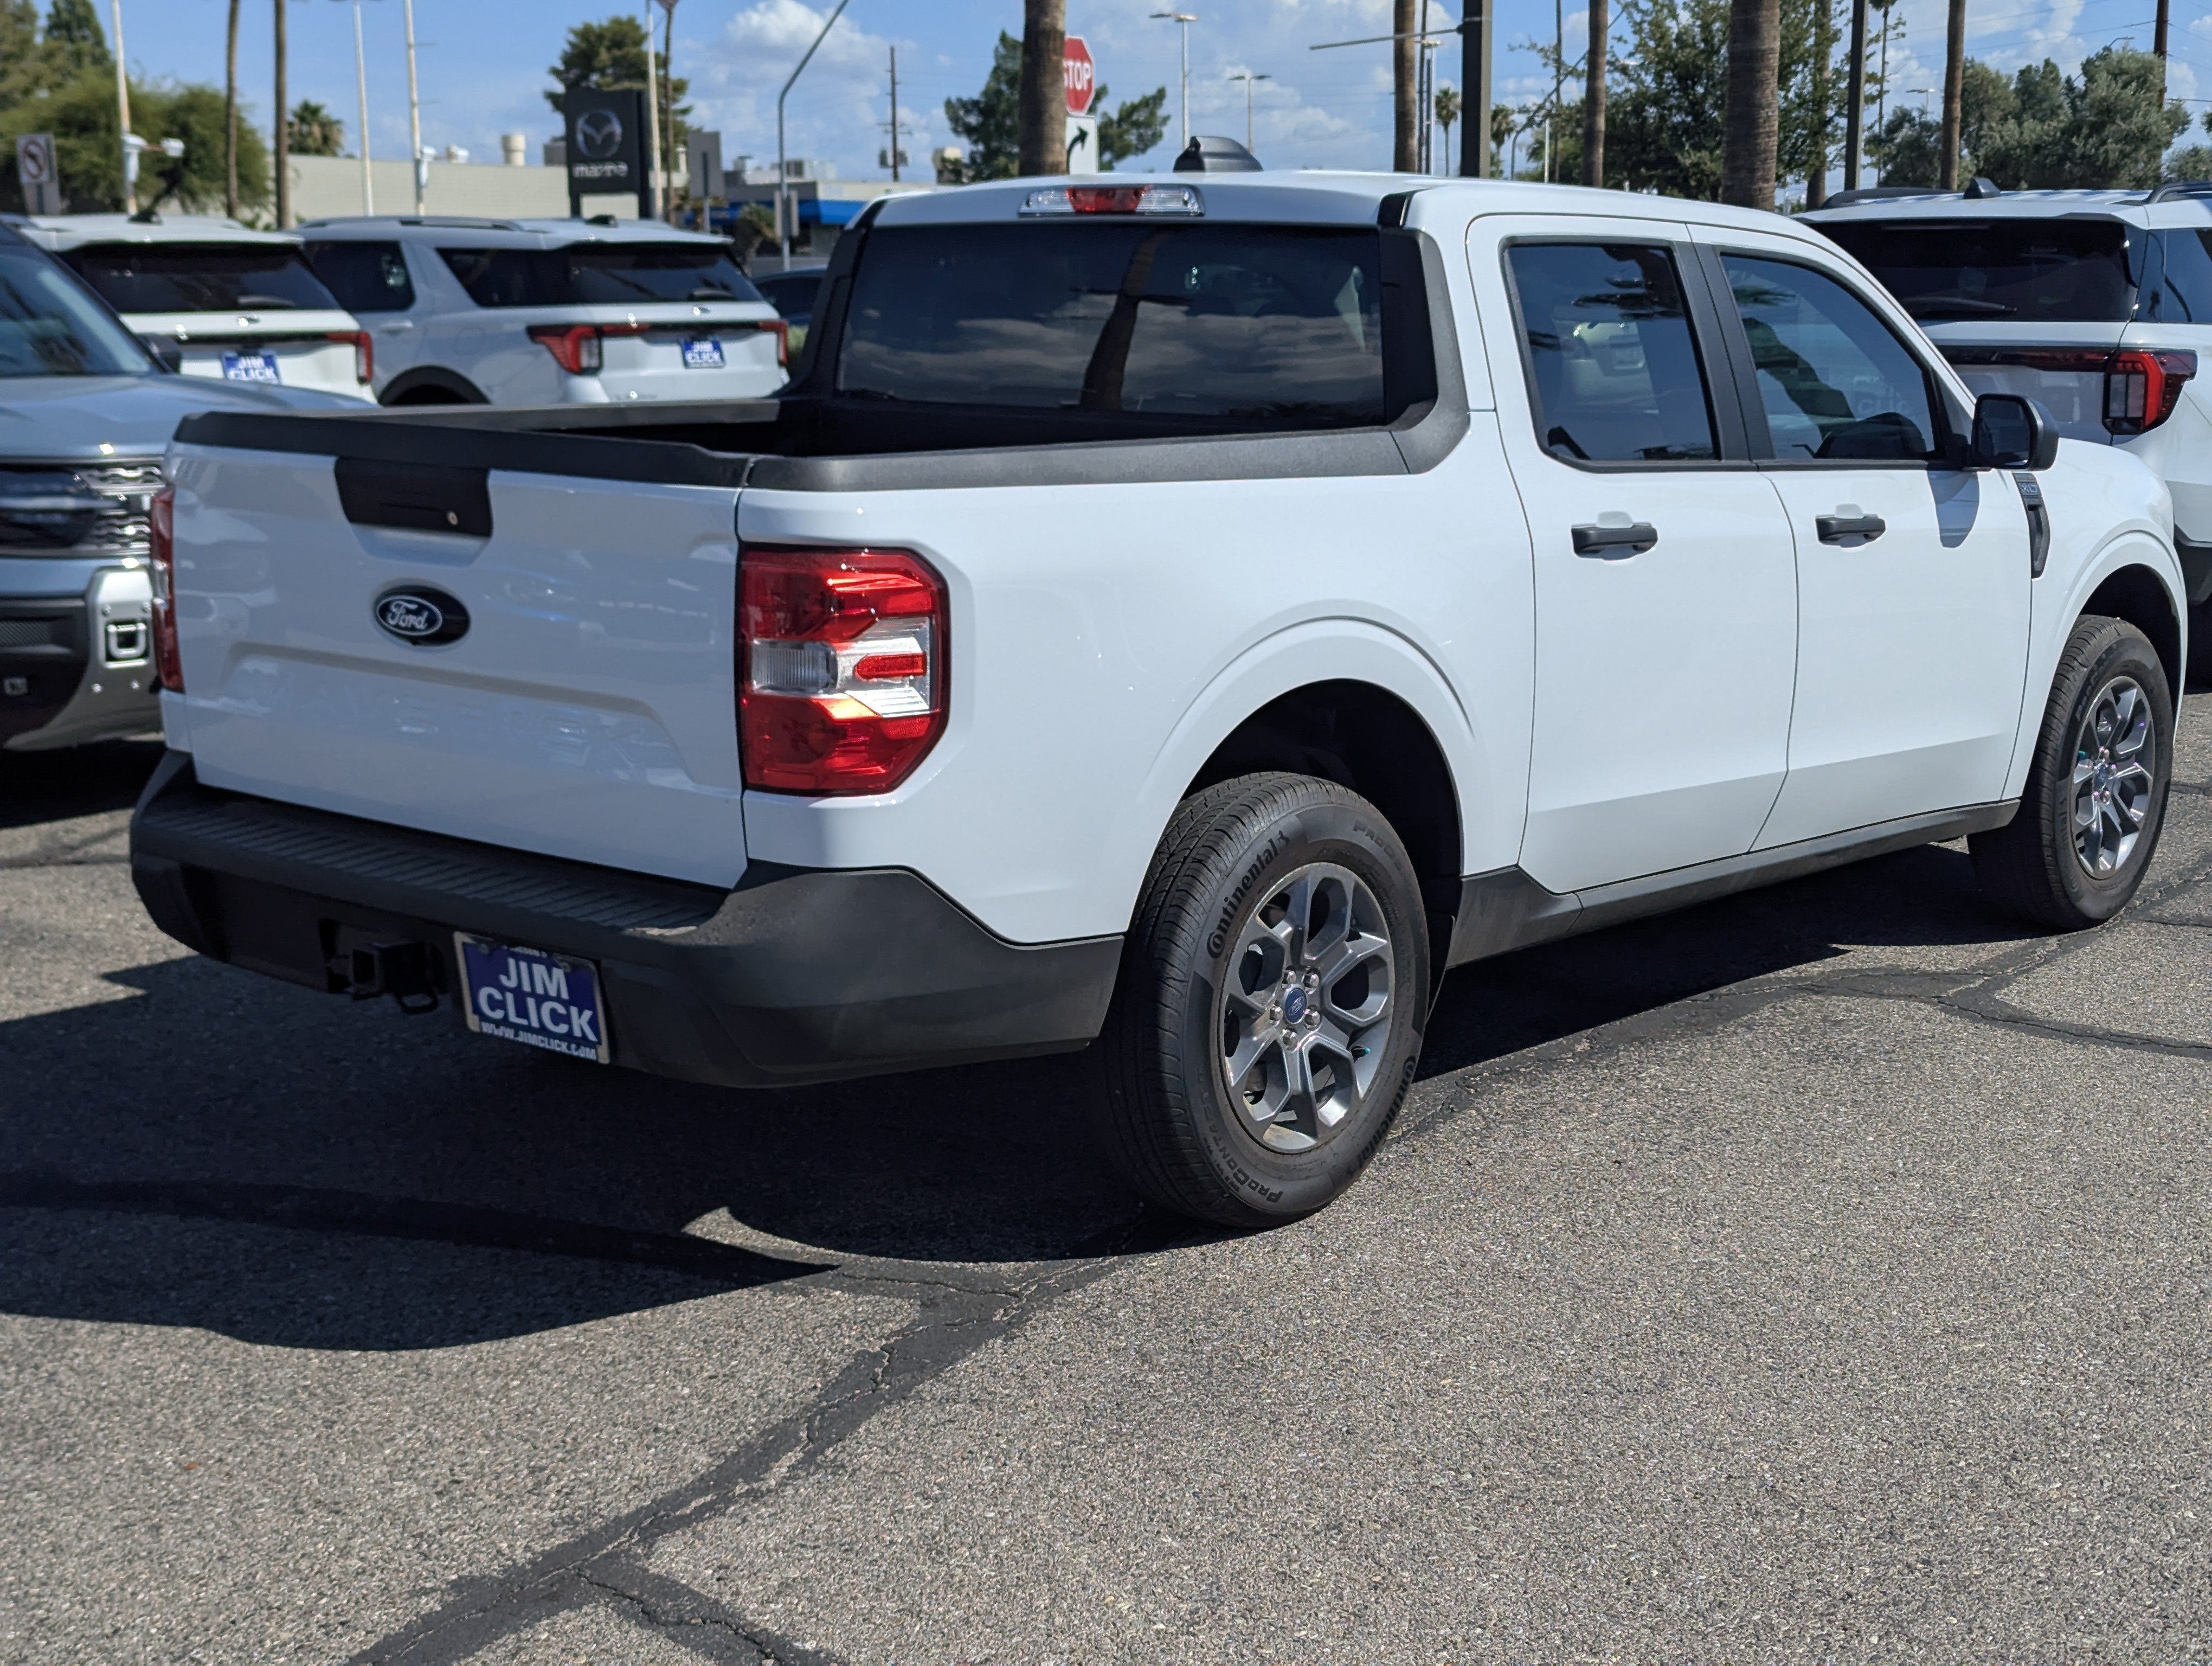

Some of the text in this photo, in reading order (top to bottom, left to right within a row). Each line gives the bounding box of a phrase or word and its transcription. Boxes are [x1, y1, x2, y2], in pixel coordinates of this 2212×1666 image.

[1063, 59, 1091, 91] STOP
[229, 368, 278, 385] CLICK
[237, 356, 265, 369] JIM
[388, 600, 428, 630] Ford
[1206, 837, 1279, 959] Continental
[499, 957, 569, 1000] JIM
[478, 986, 599, 1042] CLICK
[480, 1021, 597, 1062] WWW.JIMCLICK.COM
